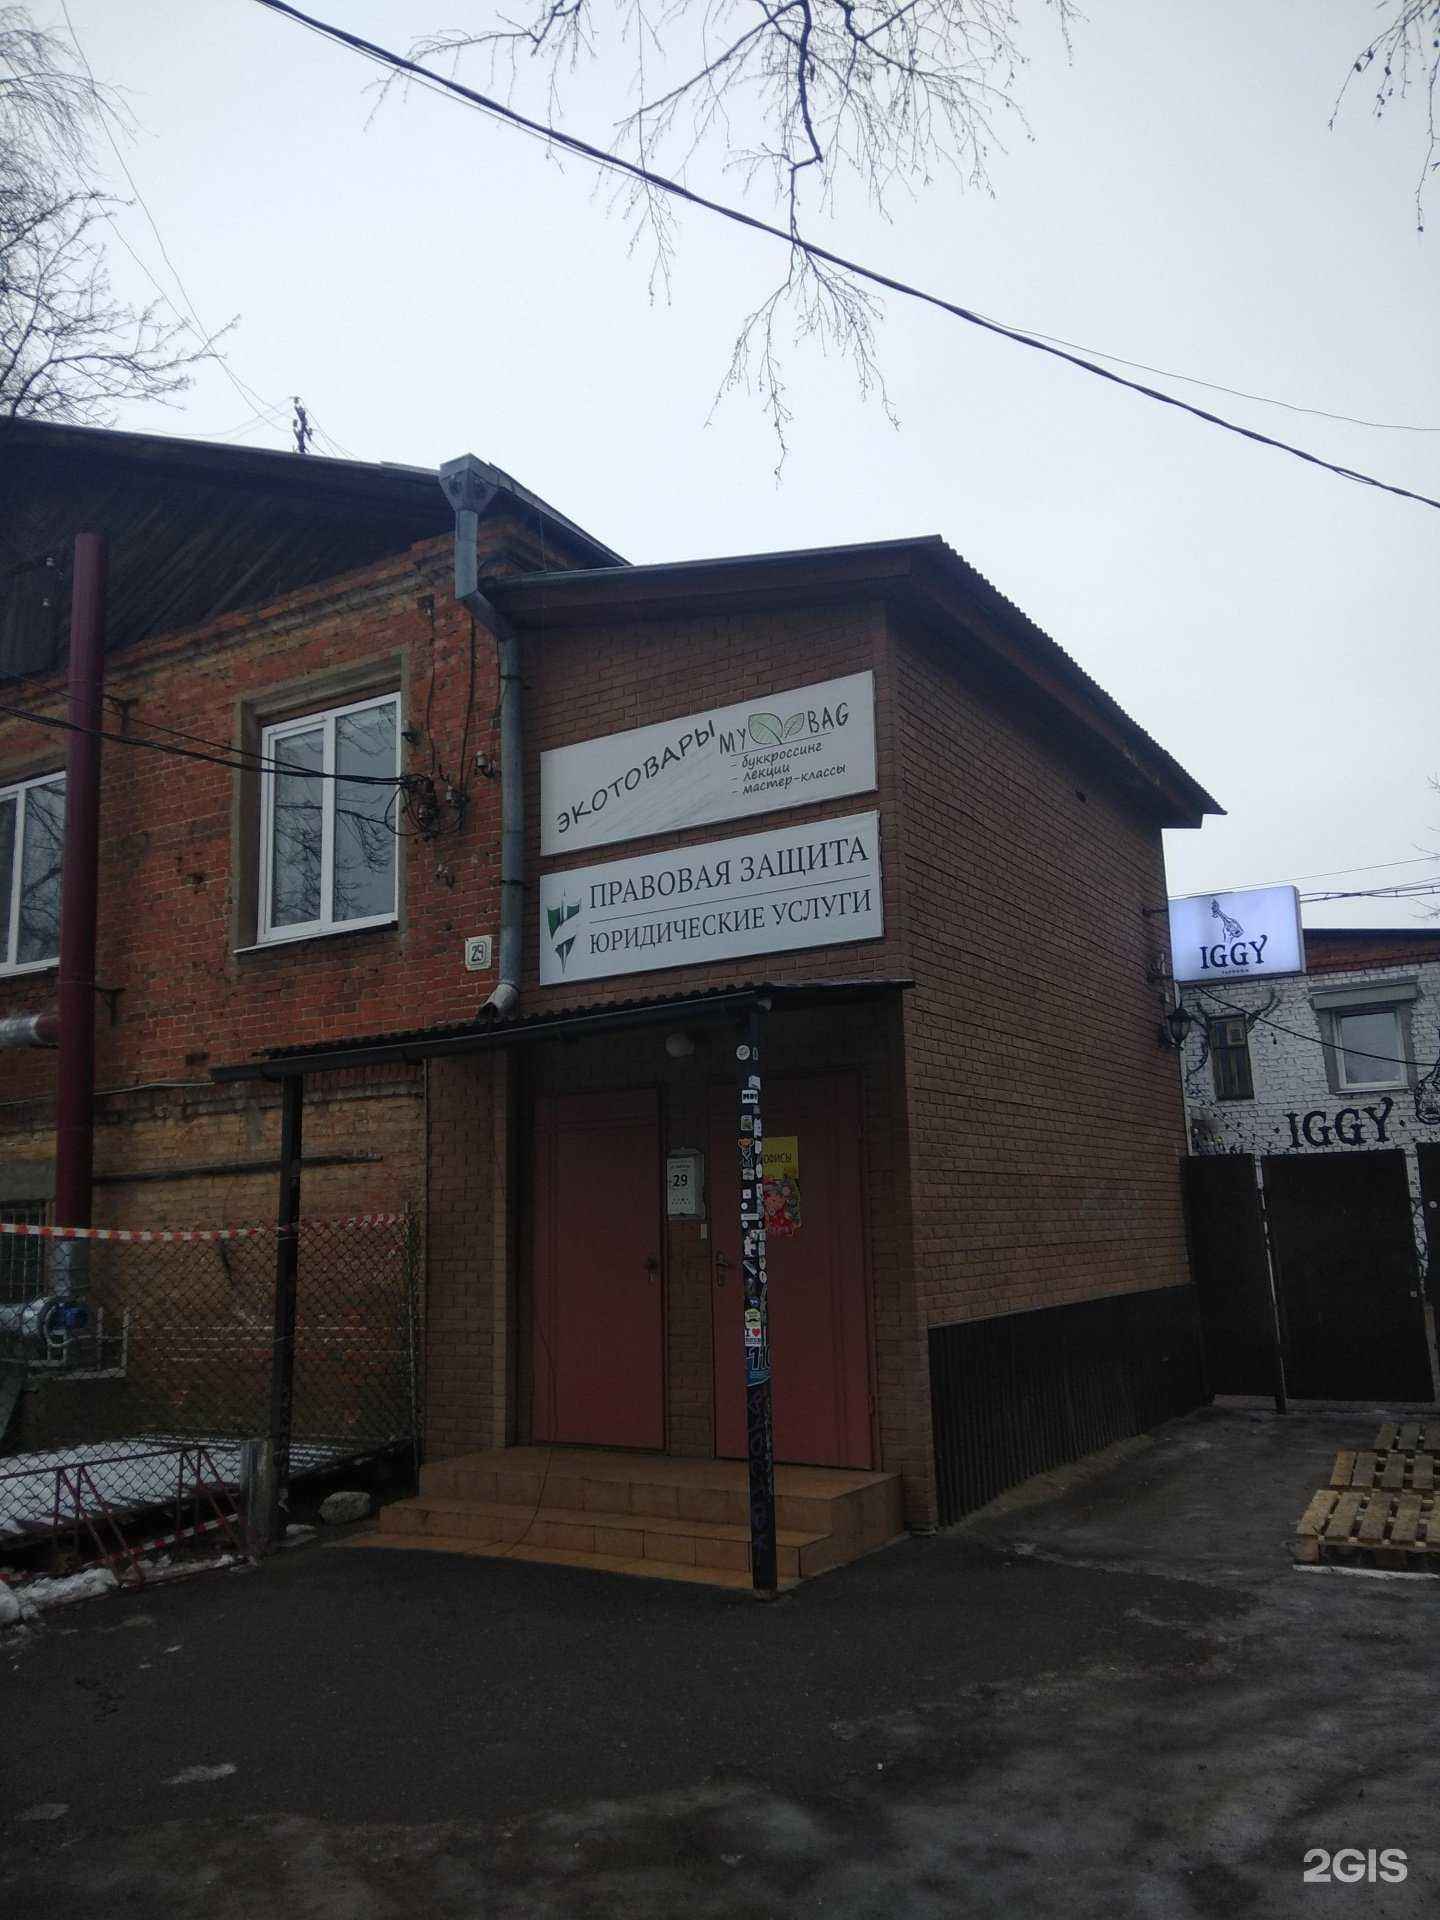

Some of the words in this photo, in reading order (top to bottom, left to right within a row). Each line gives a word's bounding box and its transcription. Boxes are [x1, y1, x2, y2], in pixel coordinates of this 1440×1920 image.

[719, 728, 748, 755] MY
[808, 702, 850, 734] BAG
[556, 720, 718, 834] ЭКОТОВАРЫ
[741, 741, 823, 771] буккроссинг
[742, 764, 791, 783] лекции
[742, 763, 847, 796] мастер-классы
[589, 859, 732, 909] ПРАВОВАЯ
[740, 836, 870, 884] ЗАЩИТА
[589, 907, 766, 954] ЮРИДИЧЕСКИЕ
[772, 889, 872, 927] УСЛУГИ
[1200, 934, 1269, 970] IGGY
[1285, 1096, 1395, 1149] IGGY
[673, 1174, 688, 1187] 29
